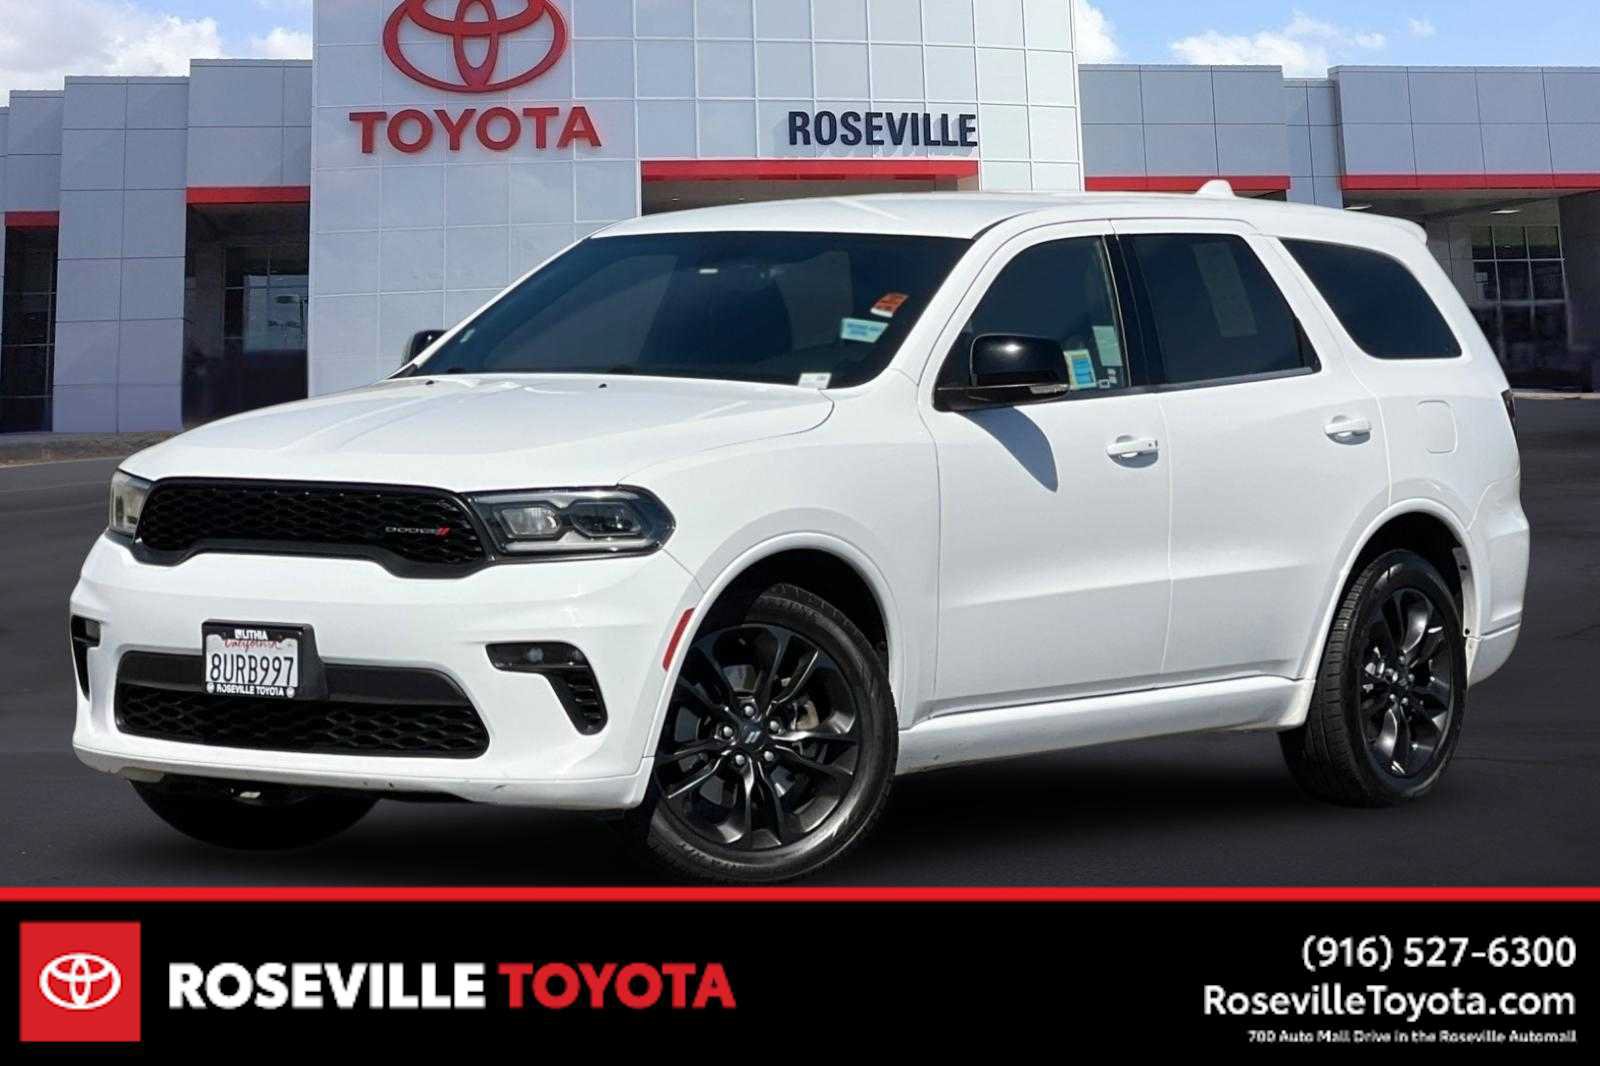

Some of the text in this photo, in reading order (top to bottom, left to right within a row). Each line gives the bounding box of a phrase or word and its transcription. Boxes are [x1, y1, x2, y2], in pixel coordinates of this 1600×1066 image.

[349, 106, 602, 153] TOYOTA
[788, 111, 978, 147] ROSEVILLE
[241, 629, 268, 640] LITHIA
[210, 653, 294, 686] 8URB997
[216, 683, 285, 697] ROSEVILLE TOYOTA
